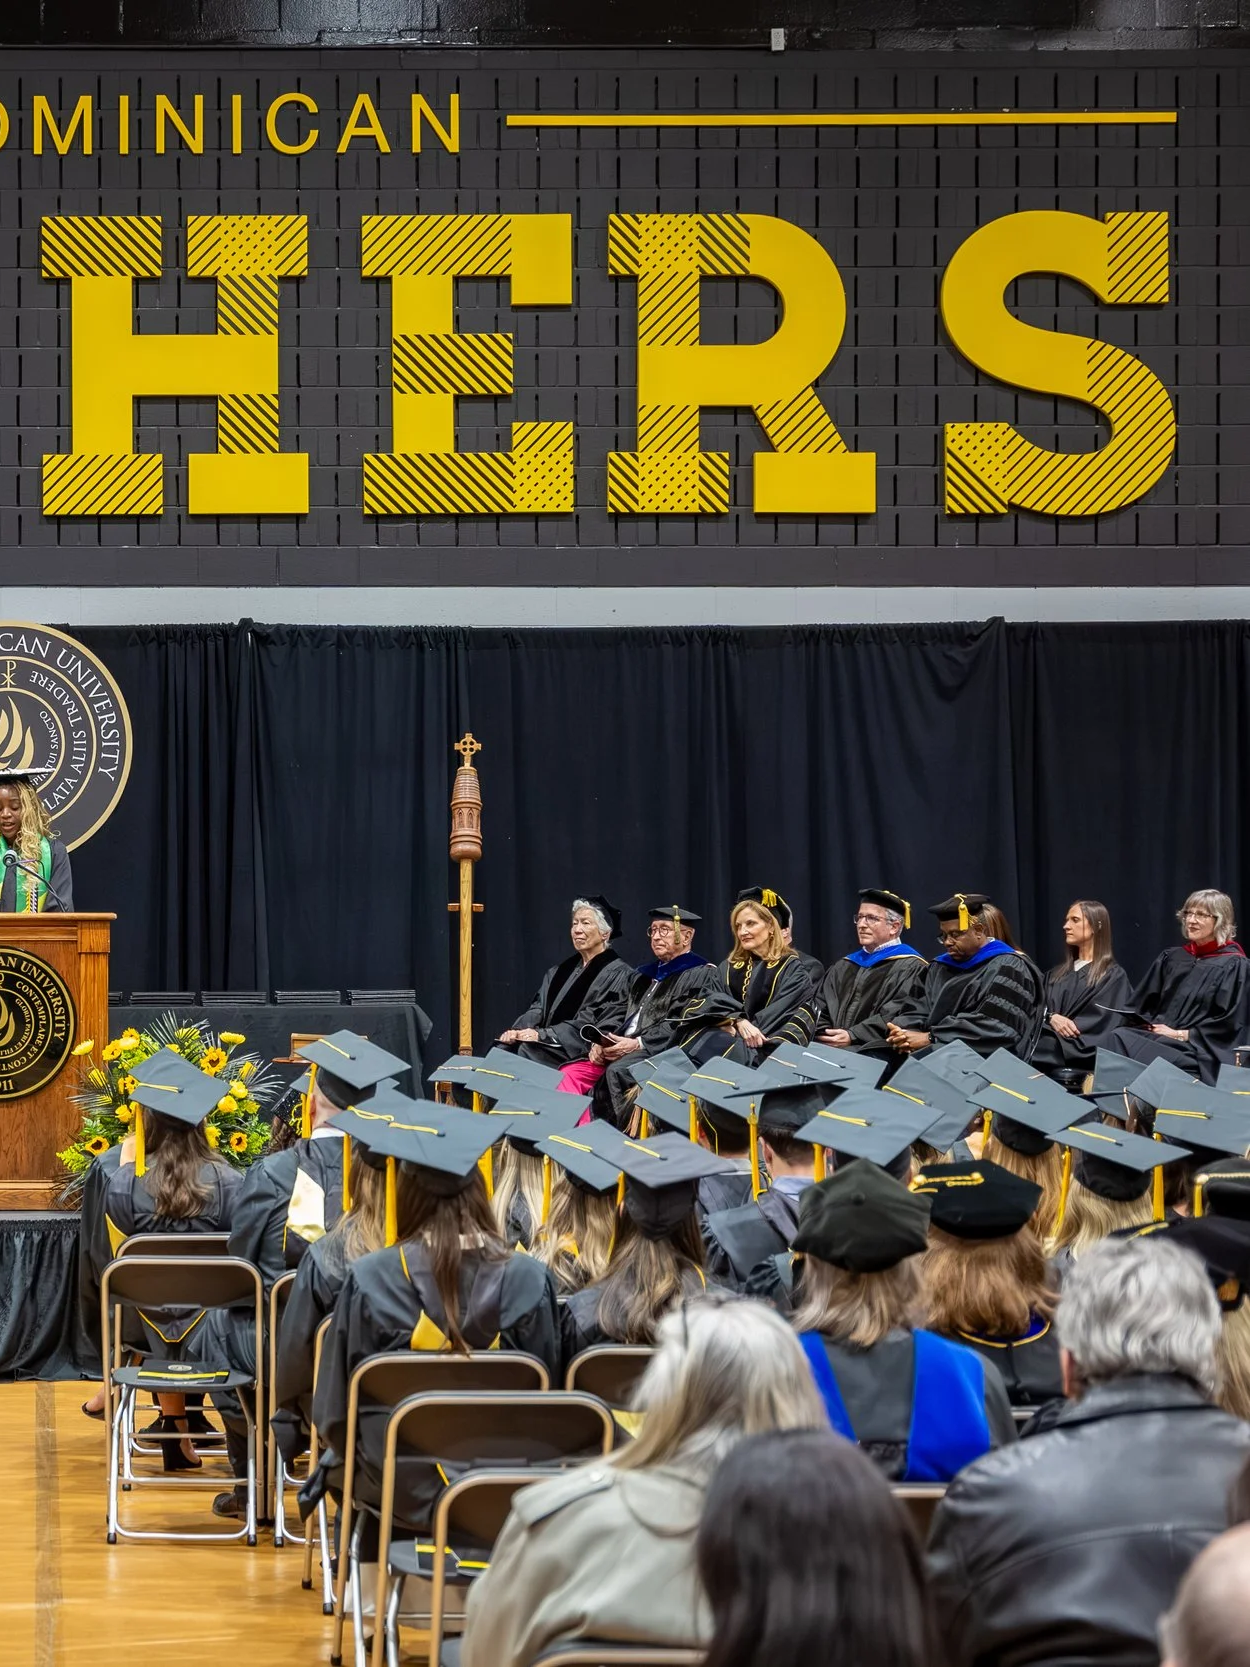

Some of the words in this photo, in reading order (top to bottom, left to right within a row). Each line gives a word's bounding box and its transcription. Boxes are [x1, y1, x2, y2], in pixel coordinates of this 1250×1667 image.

[29, 670, 82, 727] TRADERE
[56, 648, 120, 781] UNIVERSITY
[39, 711, 59, 749] SANCTO
[70, 730, 87, 774] ALIIS
[15, 998, 31, 1022] GLORIA
[15, 981, 47, 1046] CONTEMPLARE
[20, 962, 66, 1042] UNIVERSITY
[21, 1023, 31, 1043] PATRI
[27, 1046, 39, 1057] ET
